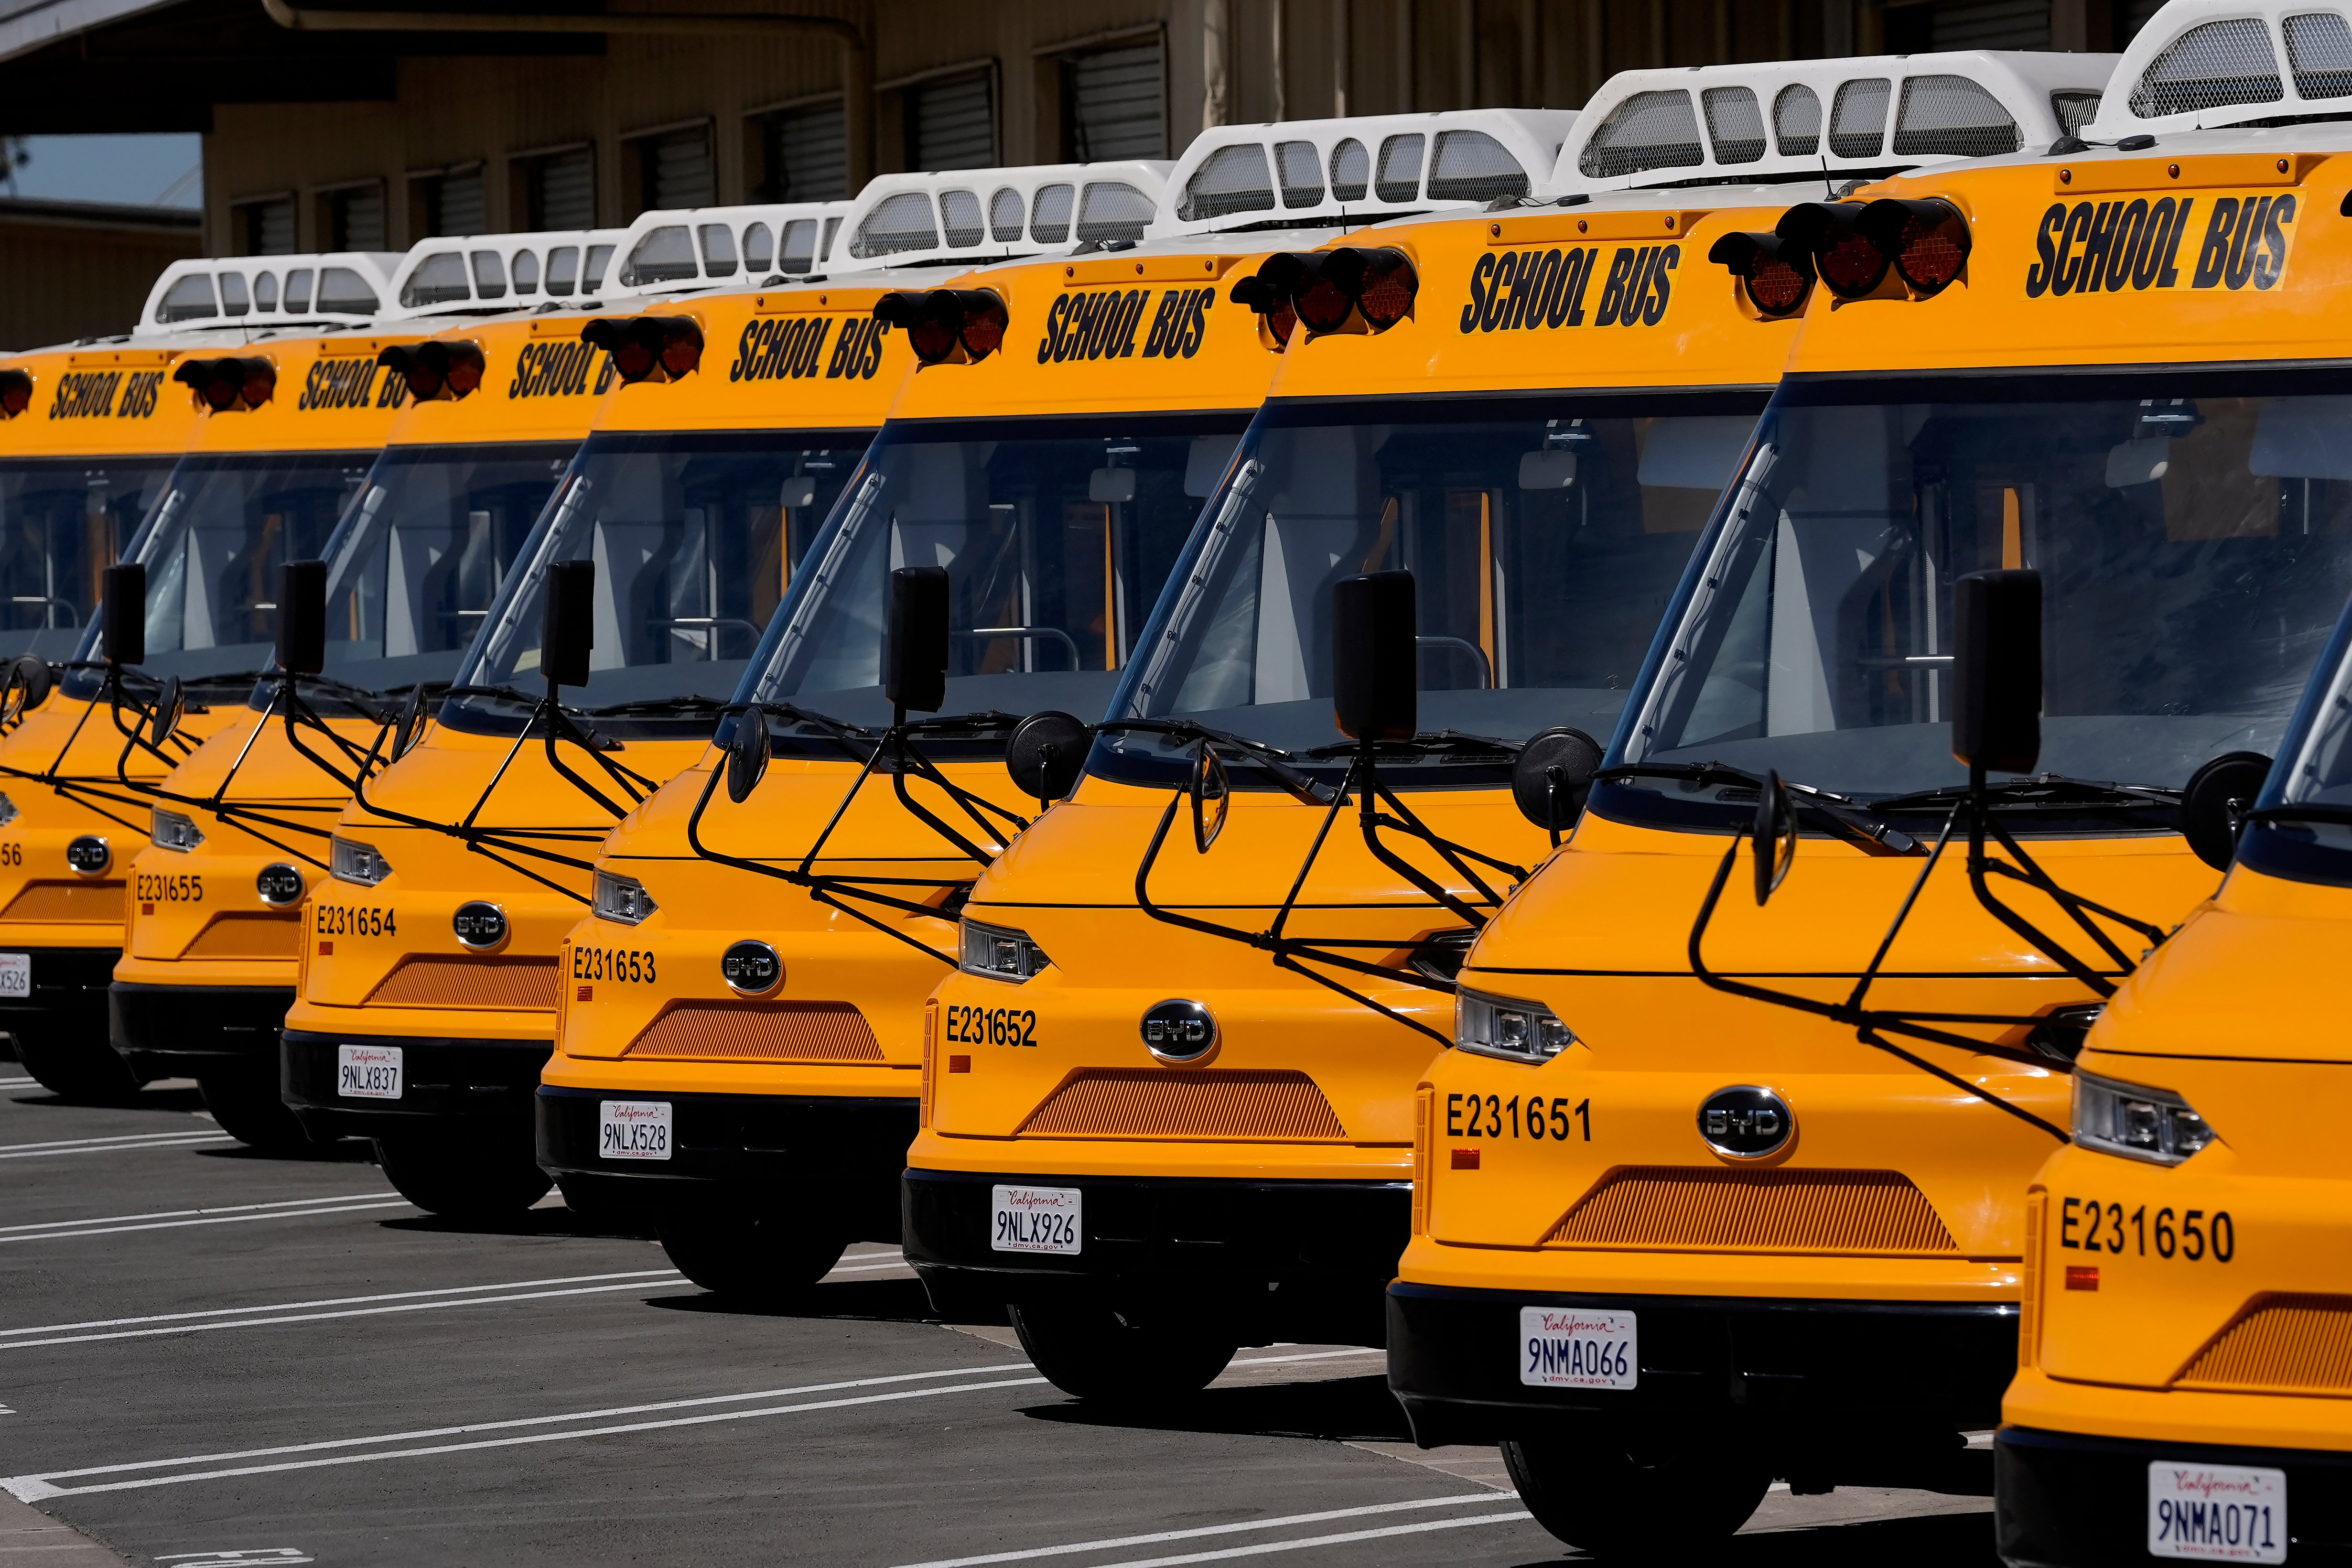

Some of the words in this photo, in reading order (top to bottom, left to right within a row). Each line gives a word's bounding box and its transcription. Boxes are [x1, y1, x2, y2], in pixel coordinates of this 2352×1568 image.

[2026, 197, 2194, 298] SCHOOL
[2192, 194, 2296, 291] BUS
[1460, 247, 1598, 334] SCHOOL
[1594, 244, 1681, 326] BUS
[1037, 290, 1151, 364] SCHOOL
[1142, 287, 1215, 358] BUS
[730, 317, 833, 382] SCHOOL
[826, 318, 891, 379] BUS
[299, 358, 378, 410] SCHOOL
[376, 366, 407, 409] BU
[509, 342, 598, 399] SCHOOL
[50, 372, 123, 420] SCHOOL
[118, 371, 165, 418] BUS
[138, 876, 203, 901] E231655
[260, 876, 297, 894] BYD
[318, 906, 396, 936] E231654
[457, 916, 499, 934] BYD
[574, 947, 656, 984] E231653
[727, 958, 772, 976] BYD
[947, 1006, 1037, 1047] E231652
[1147, 1020, 1205, 1041] BYD
[352, 1049, 389, 1064] California
[343, 1065, 397, 1090] 9NLX837
[615, 1105, 658, 1122] California
[1447, 1093, 1591, 1142] E231651
[1707, 1109, 1779, 1135] BYD
[604, 1123, 665, 1150] 9NLX528
[1010, 1190, 1064, 1210] California
[997, 1211, 1074, 1244] 9NLX926
[2062, 1197, 2234, 1263] E231650
[1544, 1313, 1614, 1336] California
[1529, 1338, 1628, 1375] 9NMA066
[2177, 1471, 2259, 1498] California
[2159, 1499, 2275, 1547] 9NMA071
